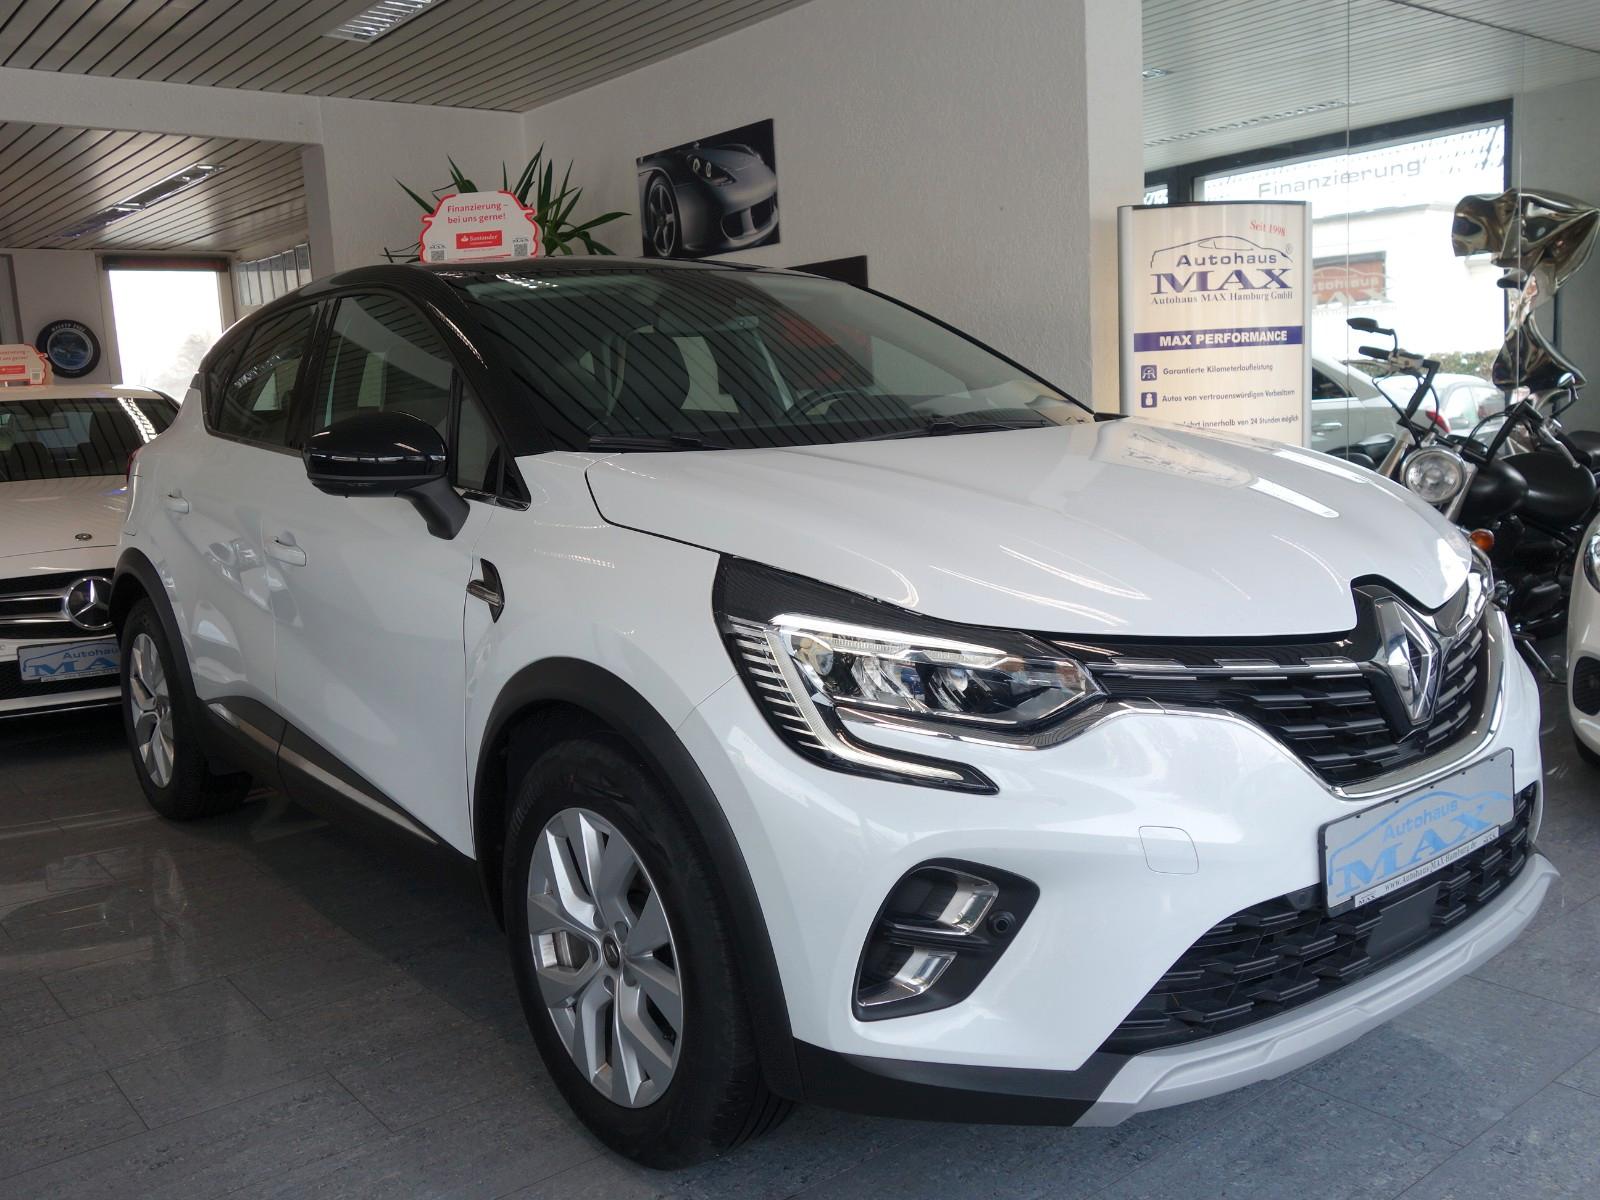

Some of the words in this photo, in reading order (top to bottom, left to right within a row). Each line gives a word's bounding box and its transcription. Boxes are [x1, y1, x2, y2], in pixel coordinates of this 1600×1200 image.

[1257, 159, 1422, 198] Finanzierung
[447, 202, 502, 213] Finanzierung
[447, 215, 461, 224] bei
[462, 214, 478, 223] uns
[479, 212, 507, 224] gerne!
[1249, 220, 1267, 232] Seit
[1268, 223, 1287, 237] 1998
[469, 233, 498, 242] Santander
[1176, 252, 1277, 267] Autohaus
[1150, 268, 1293, 295] MAX
[1151, 294, 1198, 305] Autohaus
[1200, 292, 1227, 303] MAX
[1229, 291, 1270, 303] Hamburg
[1270, 290, 1293, 301] GmbH
[1159, 334, 1192, 347] MAX
[1195, 330, 1288, 345] PERFORMANCE
[1162, 366, 1205, 376] Garantierte
[1206, 363, 1273, 374] Kilometerlaufleistung
[1162, 394, 1183, 402] Autos
[1199, 391, 1264, 401] vertrauenswürdigen
[1202, 416, 1236, 428] innerhalb
[1237, 418, 1250, 426] von
[1250, 417, 1258, 425] 24
[1259, 416, 1281, 425] Stunden
[1383, 799, 1459, 842] Autohaus
[1335, 801, 1493, 898] MAX
